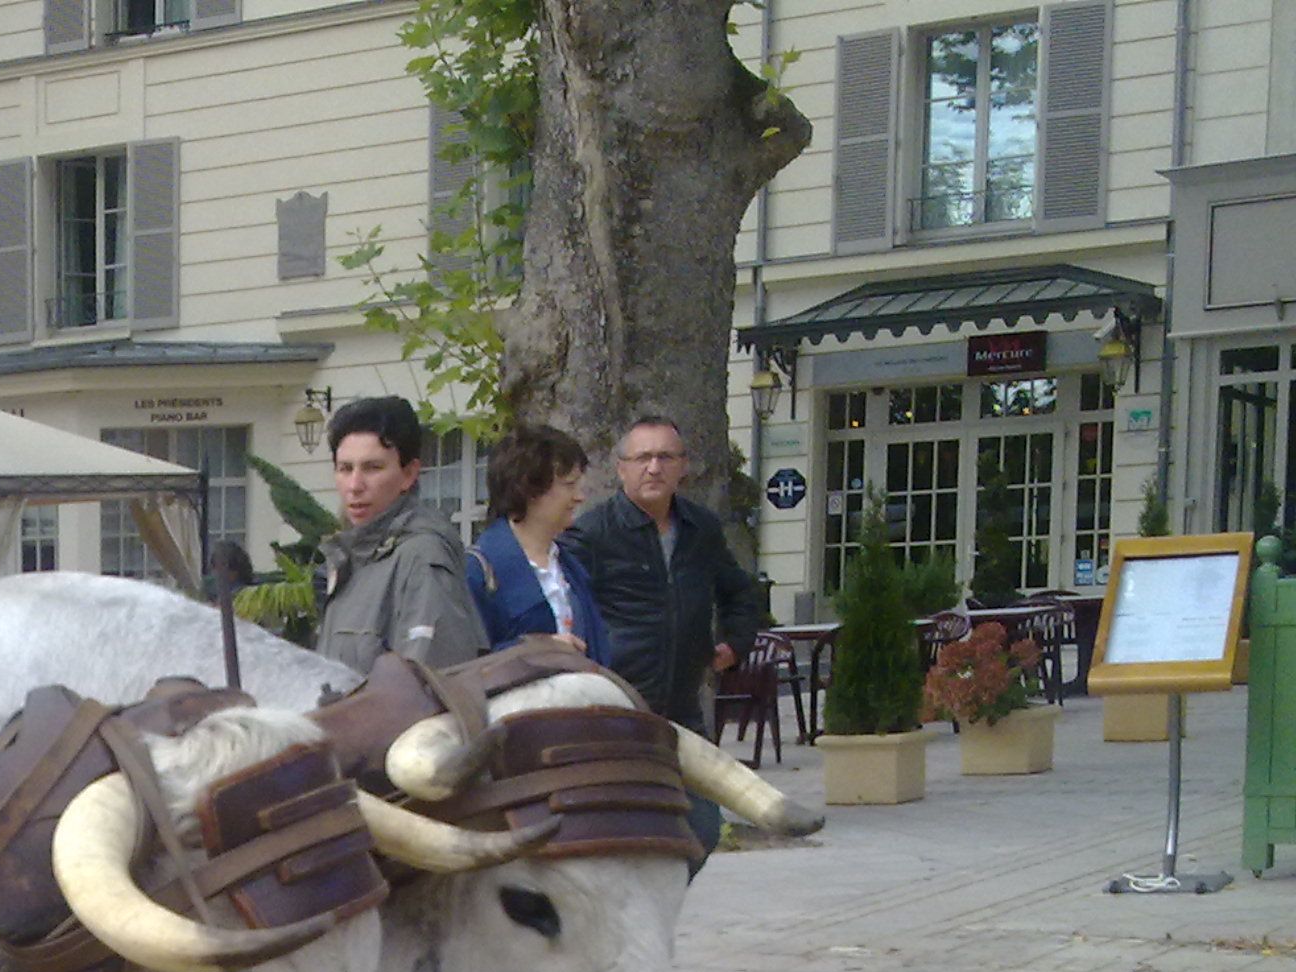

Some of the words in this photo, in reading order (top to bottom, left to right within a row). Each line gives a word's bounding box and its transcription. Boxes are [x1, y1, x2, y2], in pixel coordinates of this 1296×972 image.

[975, 348, 1032, 361] Mercure
[135, 399, 155, 409] LES
[151, 413, 183, 423] PIANO
[186, 411, 208, 421] BAR
[779, 481, 793, 497] H
